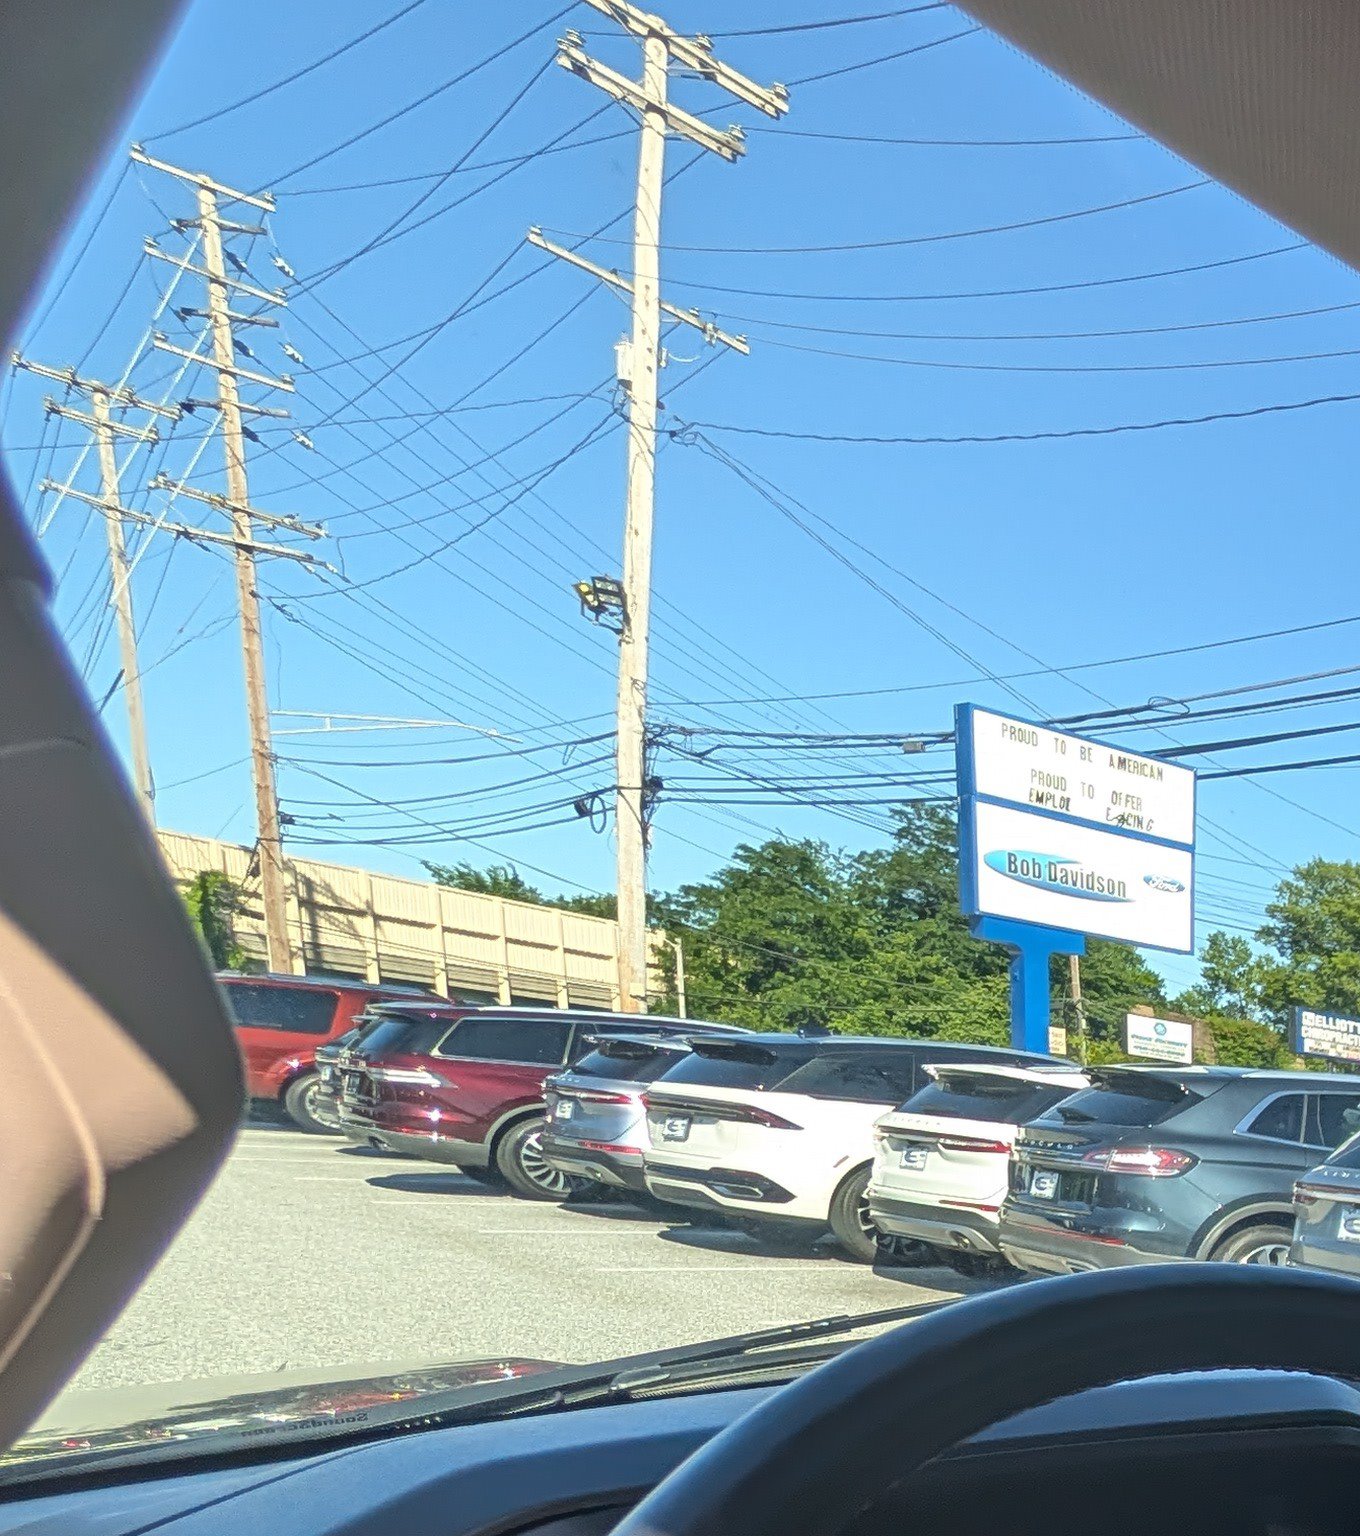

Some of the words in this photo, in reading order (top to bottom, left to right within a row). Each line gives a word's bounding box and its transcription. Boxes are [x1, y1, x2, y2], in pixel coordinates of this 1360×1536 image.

[1001, 722, 1038, 747] PROUD
[1053, 736, 1067, 756] TO
[1080, 746, 1093, 763] BE
[1109, 753, 1164, 783] AMERICAN
[1030, 768, 1067, 792] PROUD
[1081, 781, 1095, 800] TO
[1110, 790, 1143, 812] OFFER
[1007, 852, 1042, 880] Bob
[1047, 861, 1127, 899] Davidson
